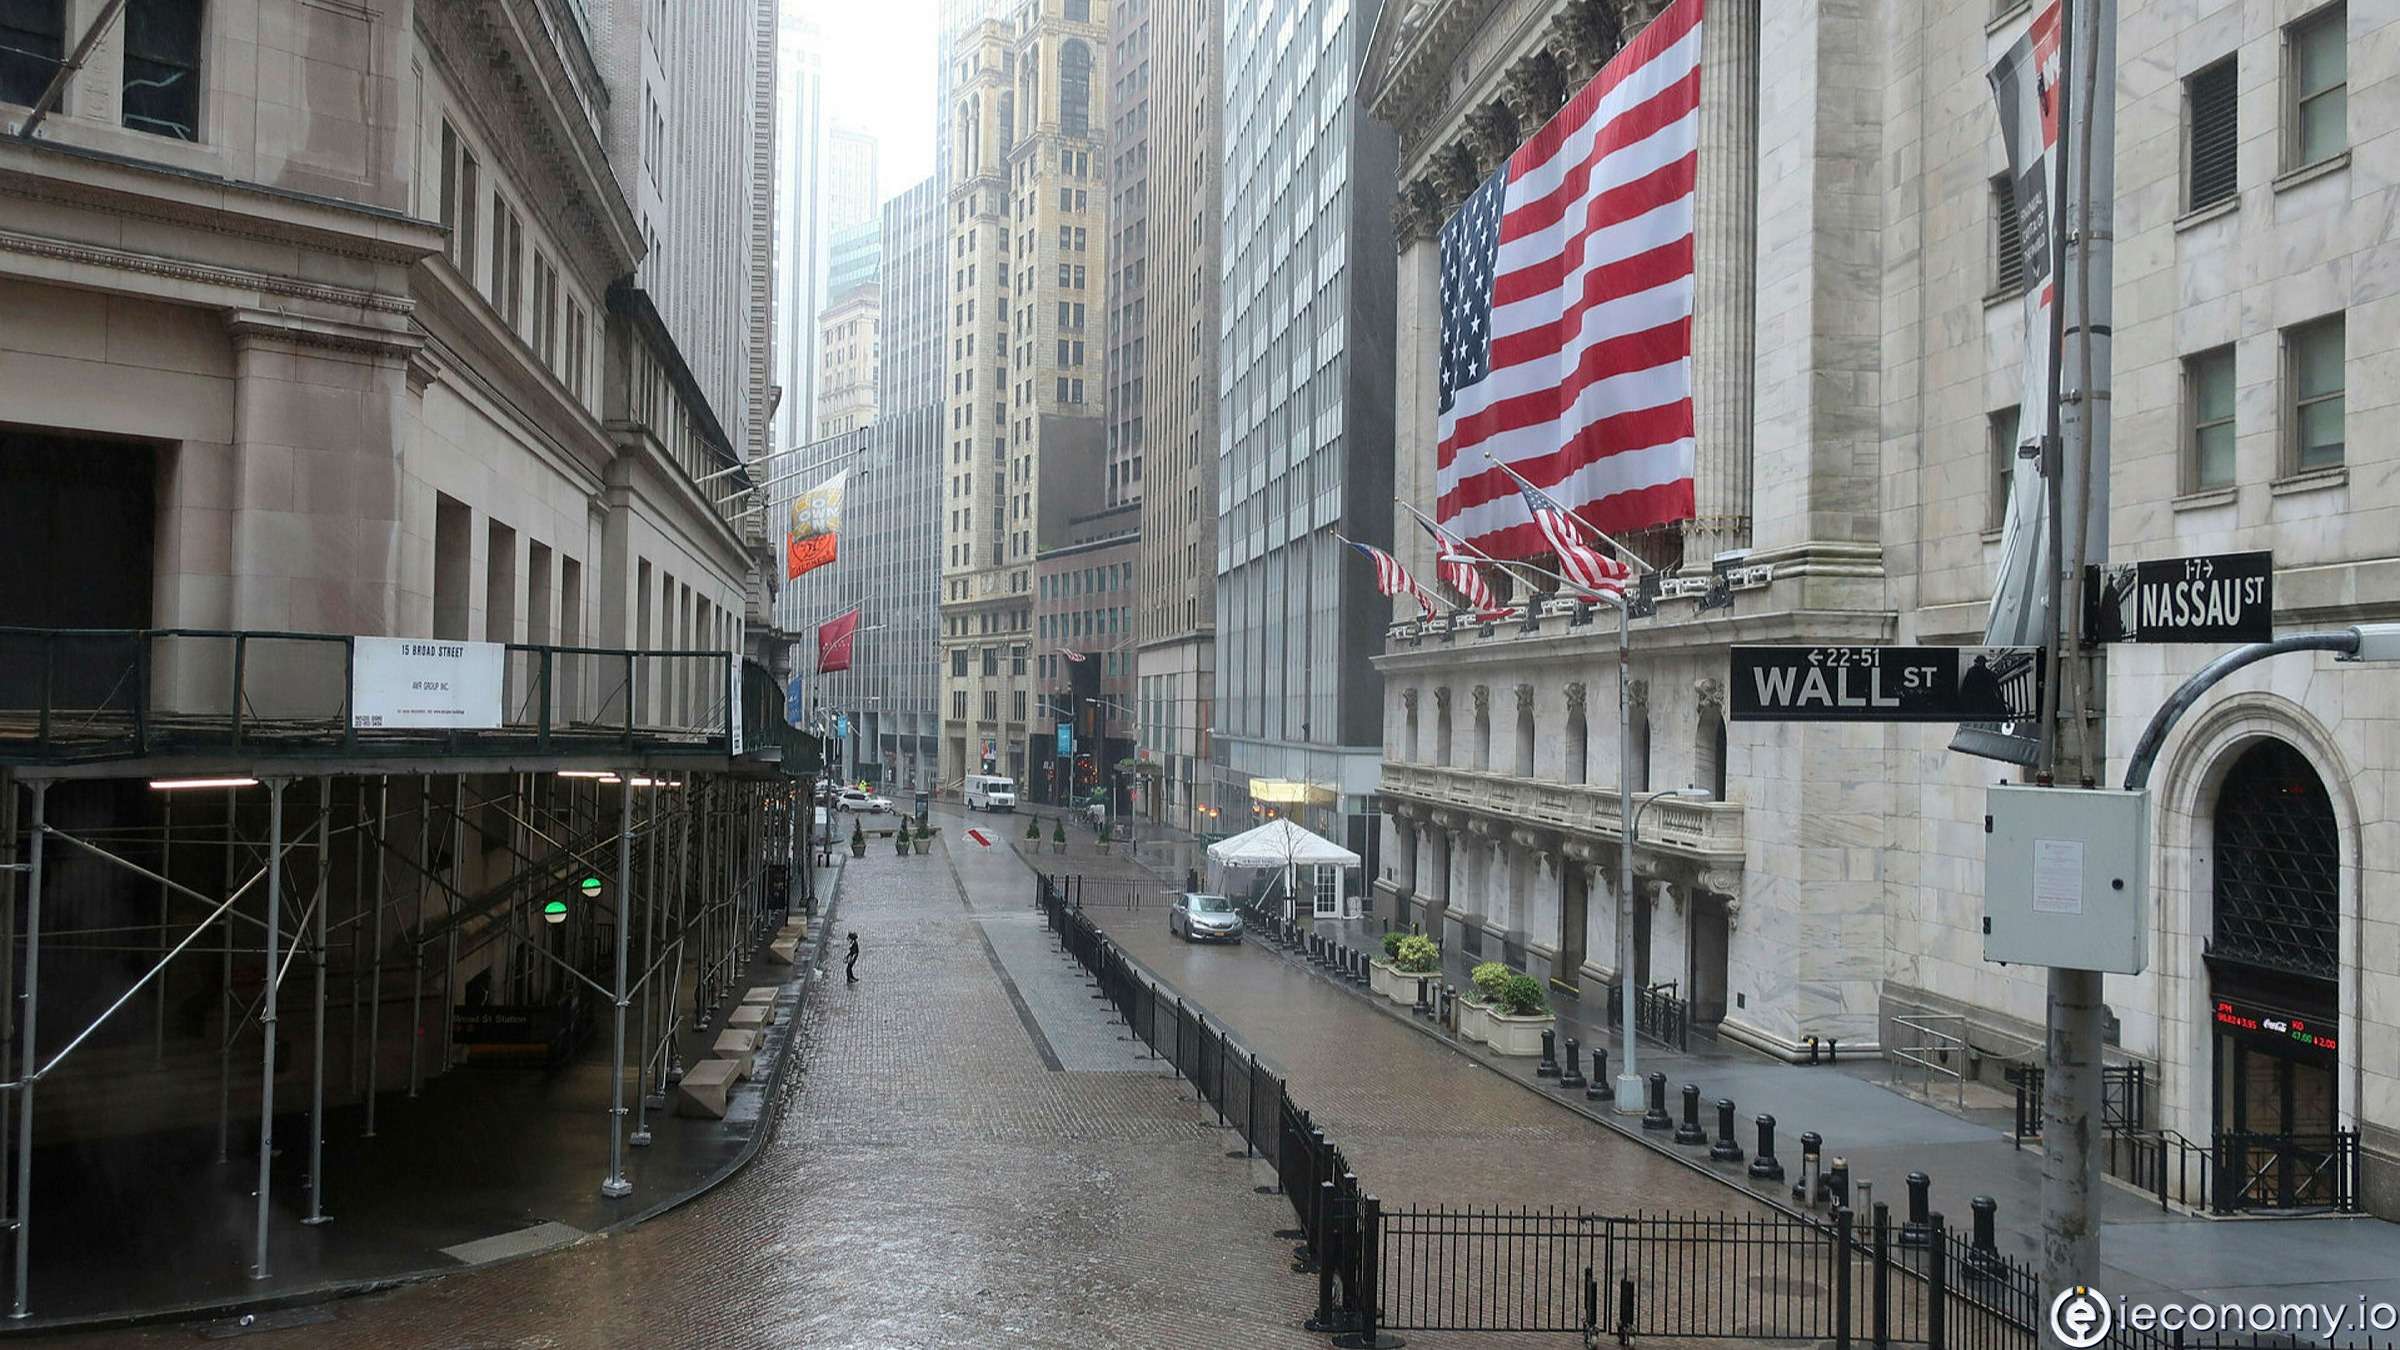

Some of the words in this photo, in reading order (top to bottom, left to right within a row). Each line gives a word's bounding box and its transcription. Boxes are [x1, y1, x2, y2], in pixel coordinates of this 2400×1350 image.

[2185, 559, 2202, 581] 1-7
[2142, 580, 2242, 628] NASSAU
[2244, 576, 2265, 606] ST
[401, 644, 410, 656] 15
[412, 645, 436, 657] BROAD
[438, 646, 464, 658] STREET
[1827, 648, 1880, 667] 22-51
[1754, 667, 1899, 707] WALL
[1903, 666, 1938, 688] ST
